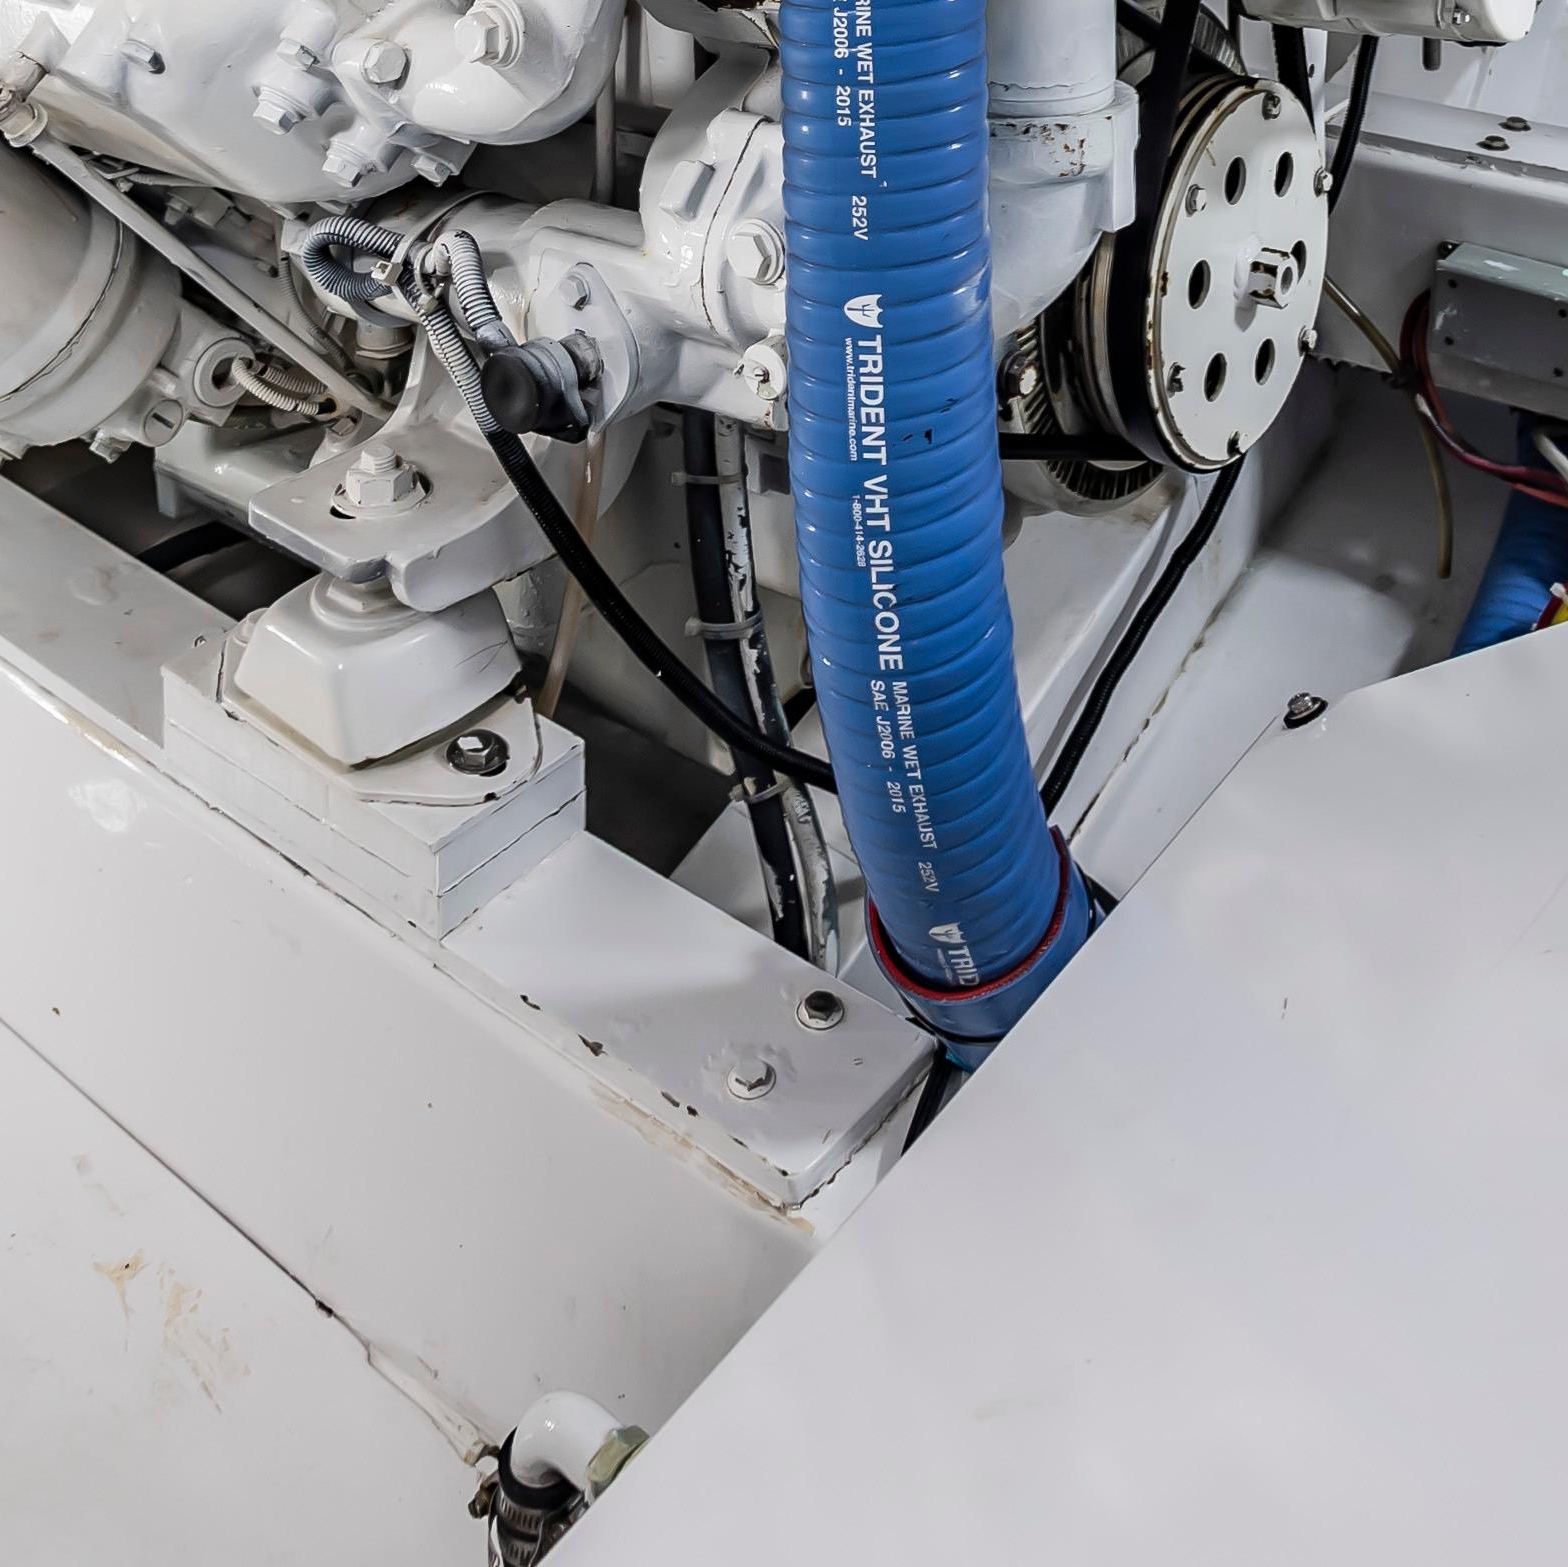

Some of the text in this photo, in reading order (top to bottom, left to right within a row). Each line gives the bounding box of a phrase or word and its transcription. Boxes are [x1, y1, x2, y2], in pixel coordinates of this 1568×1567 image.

[833, 7, 849, 59] J2006
[856, 43, 874, 84] WET
[836, 85, 852, 127] 2015
[858, 89, 877, 178] EXHAUST
[852, 195, 869, 241] 252V
[844, 337, 858, 462] www.tridentmarine.com
[858, 334, 904, 671] TRIDENT VHT SILICONE
[870, 679, 889, 711] SAE
[876, 715, 896, 759] J2006
[892, 681, 938, 849] MARINE WET EXHAUST
[887, 781, 907, 814] 2015
[918, 861, 940, 893] 252V
